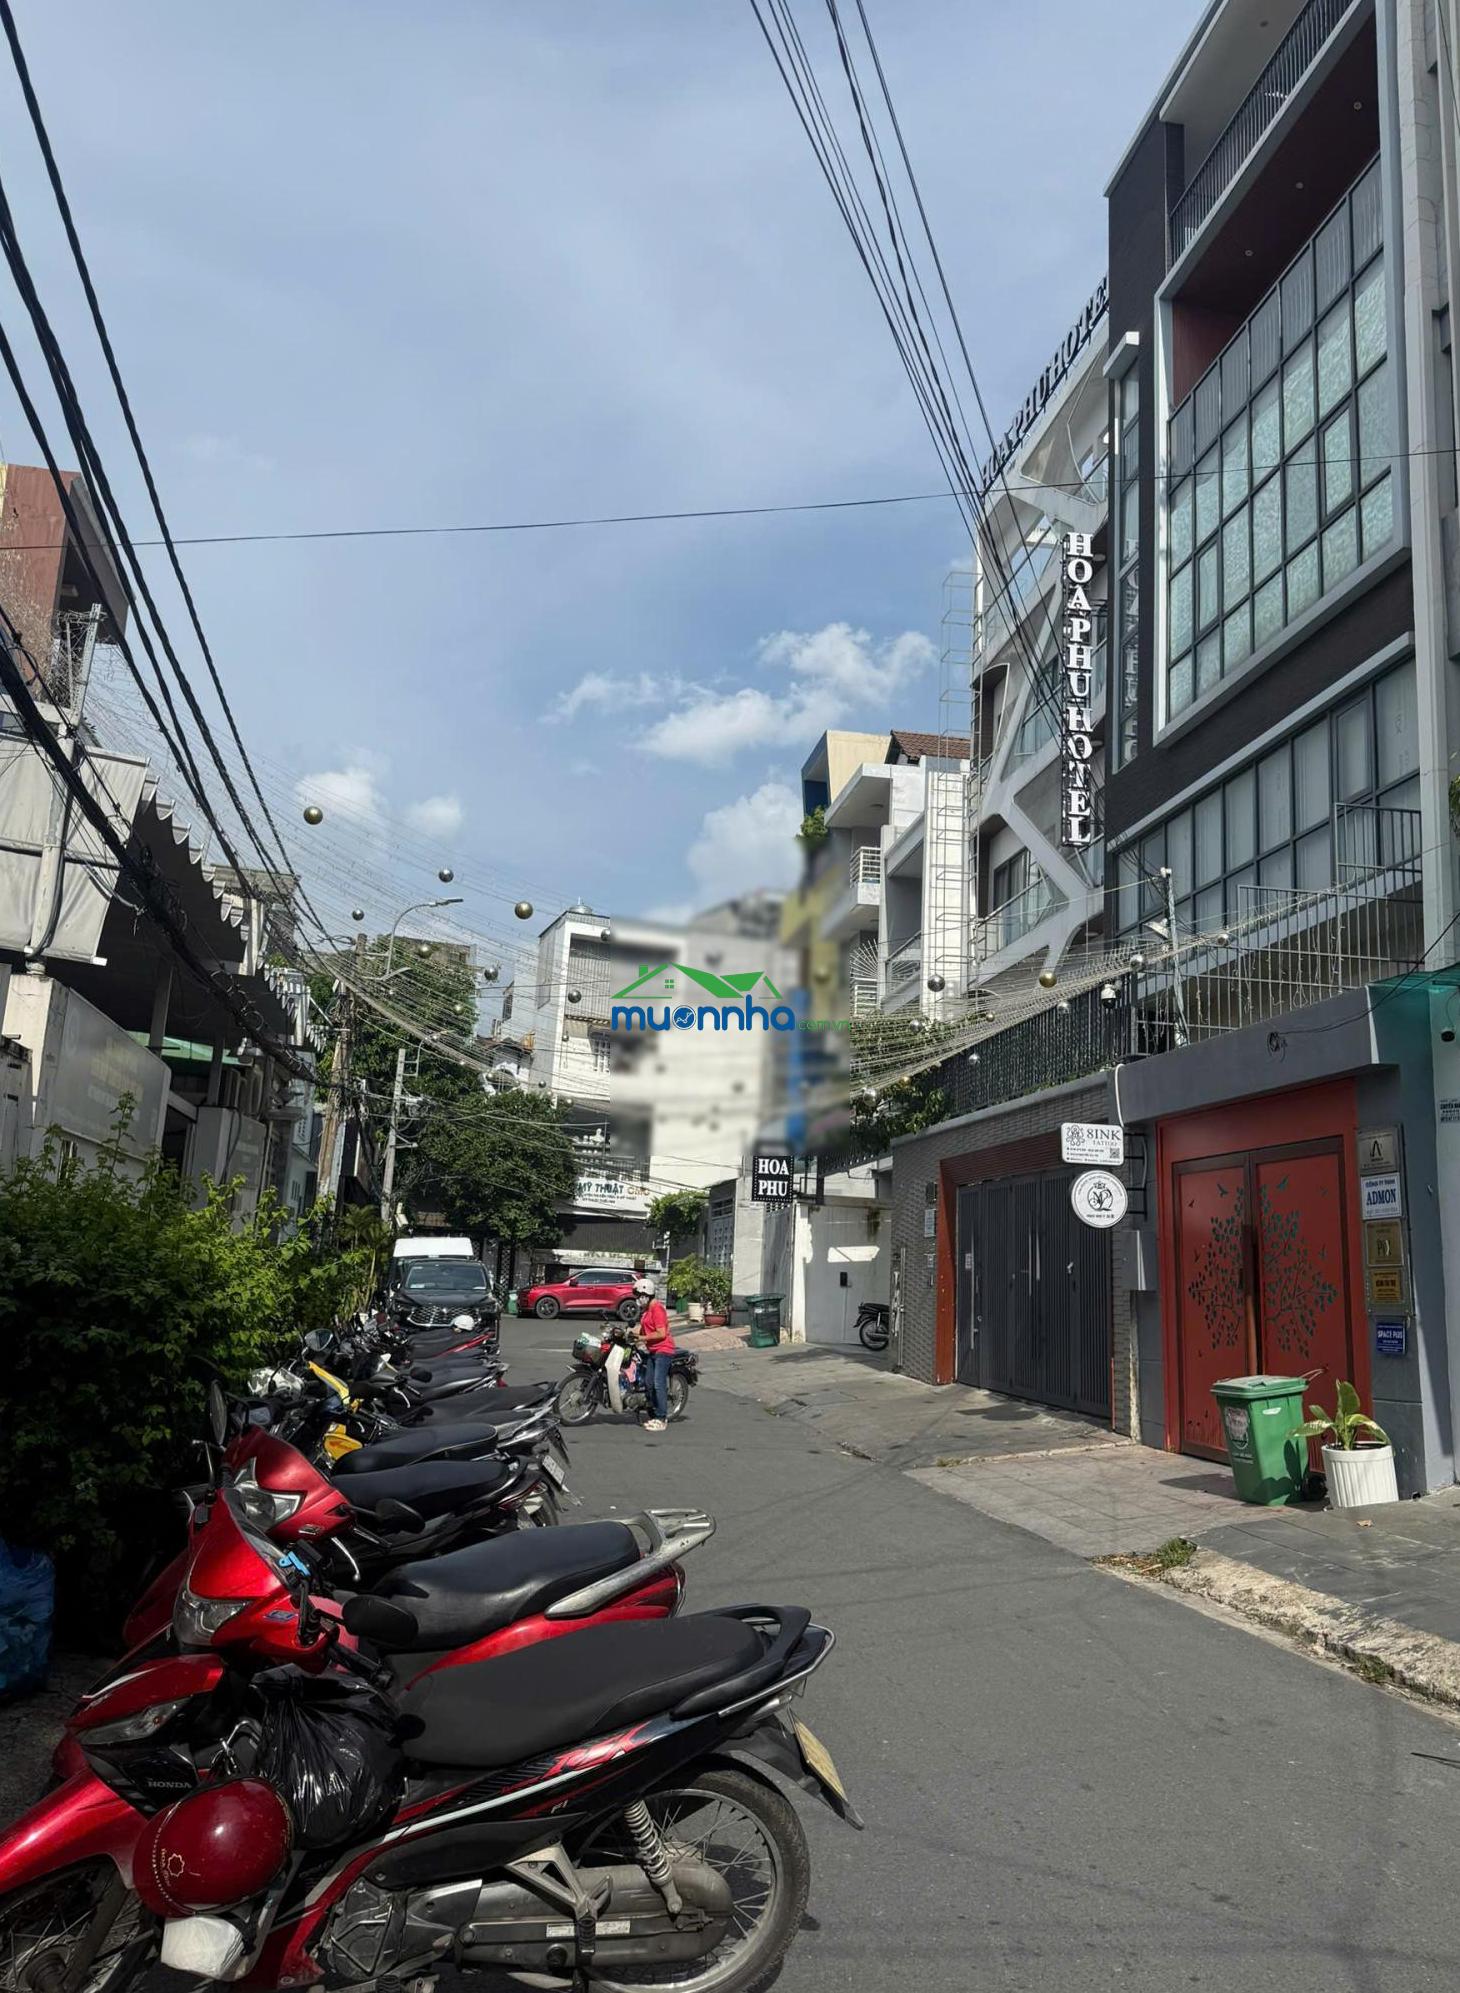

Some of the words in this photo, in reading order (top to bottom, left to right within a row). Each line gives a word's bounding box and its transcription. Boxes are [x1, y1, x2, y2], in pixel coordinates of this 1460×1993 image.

[758, 1158, 790, 1176] HOA
[758, 1179, 789, 1197] PHU
[1366, 1188, 1396, 1206] ADMON
[148, 1781, 193, 1789] HONDA
